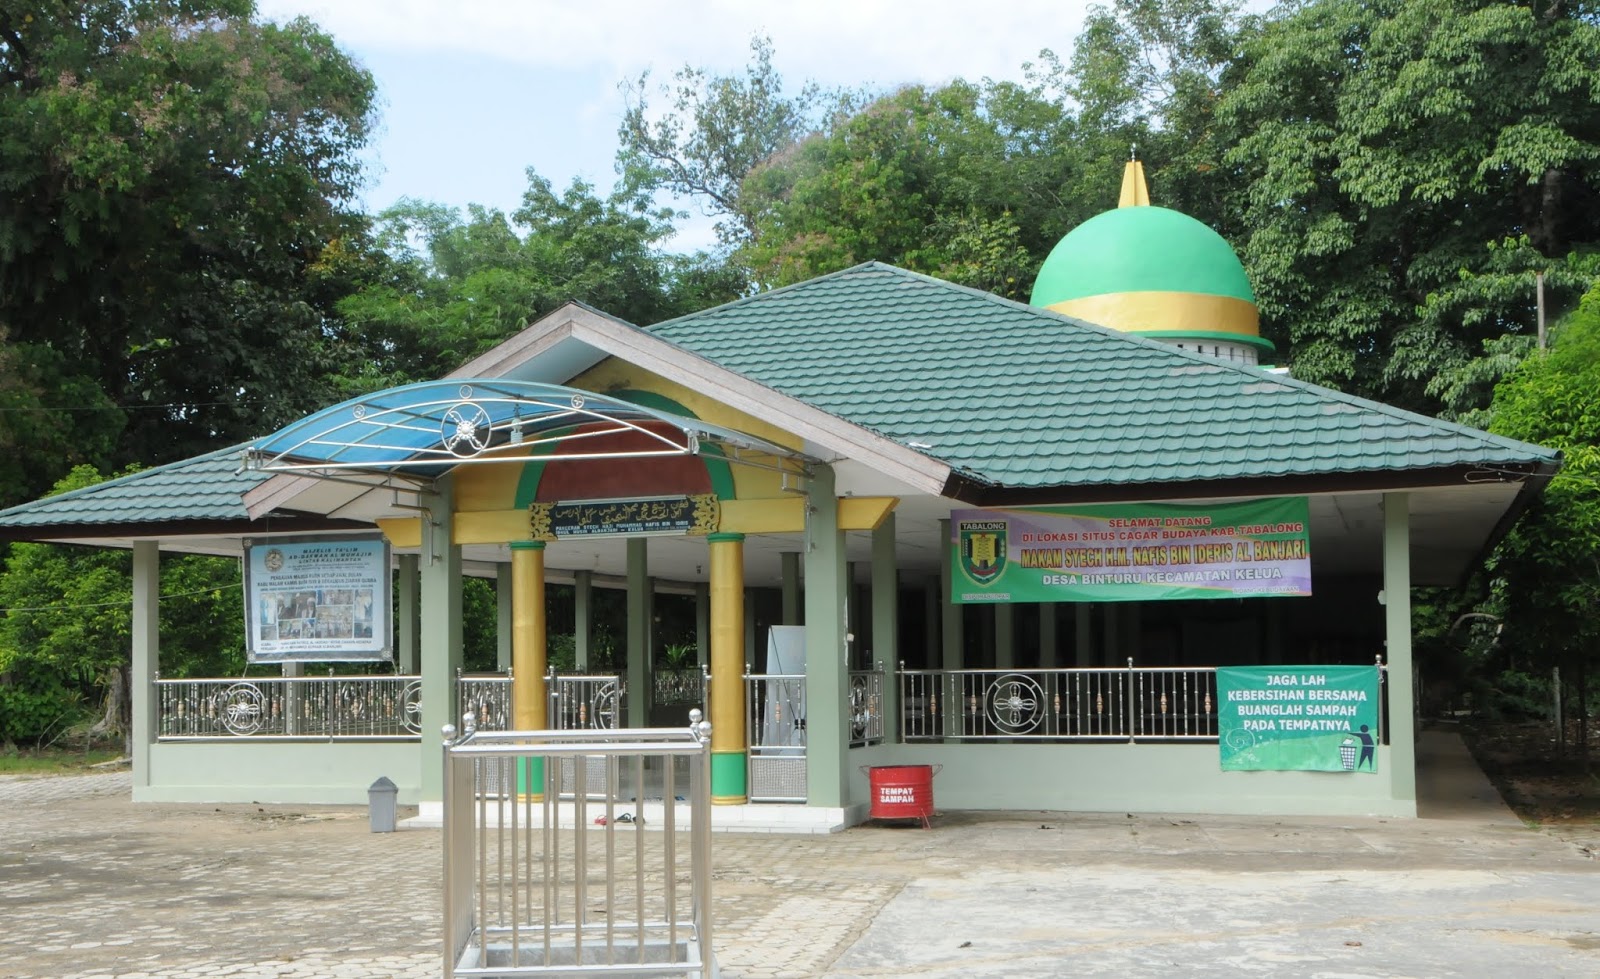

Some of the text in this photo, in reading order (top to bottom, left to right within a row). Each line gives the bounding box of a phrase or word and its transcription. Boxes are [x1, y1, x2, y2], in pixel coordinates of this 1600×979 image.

[962, 522, 1005, 530] TABALONG
[1109, 517, 1211, 528] SELAMAT DATANG
[1022, 534, 1033, 542] DI
[1038, 533, 1077, 541] LOKASI
[1082, 532, 1115, 540] SITUS
[1120, 531, 1158, 540] CAGAR
[1163, 530, 1206, 539] BUDAYA
[1021, 539, 1306, 569] MAKAM SYECH H.M. NAFIS BIN IDERIS AL BANJARI
[1043, 568, 1282, 585] DESA BINTURU KECAMATAN KELUA
[1266, 675, 1326, 686] JAGA LAH
[1228, 690, 1367, 701] KEBERSIHAN BERSAMA
[1238, 705, 1356, 716] BUANGLAH SAMPAH
[1244, 720, 1351, 731] PADA TEMPATNYA
[880, 787, 913, 795] TEMPAT
[880, 795, 914, 803] SAMPAH
